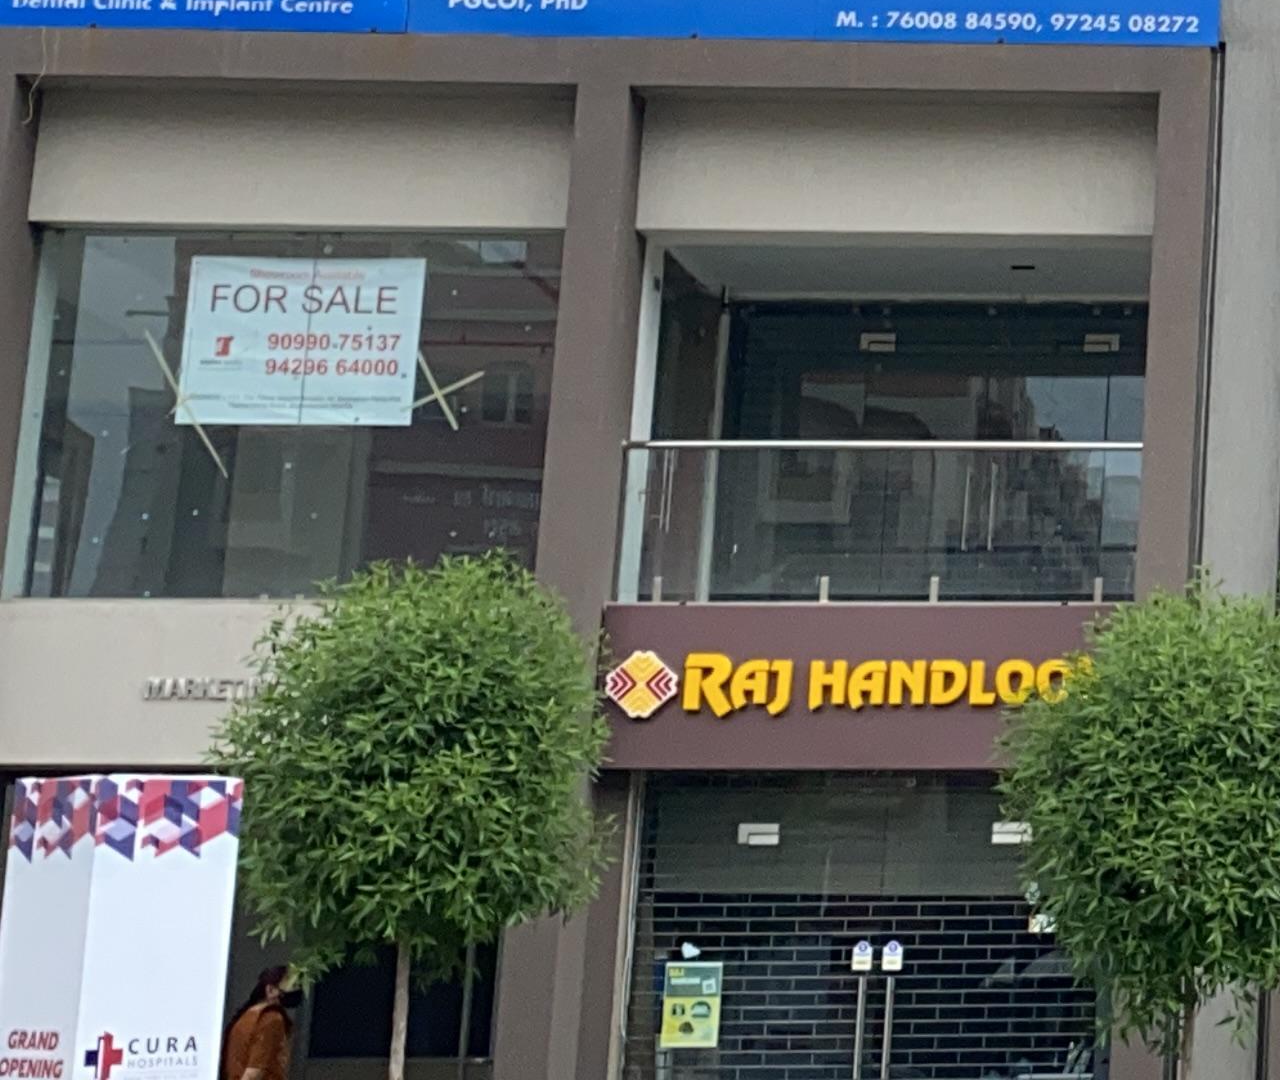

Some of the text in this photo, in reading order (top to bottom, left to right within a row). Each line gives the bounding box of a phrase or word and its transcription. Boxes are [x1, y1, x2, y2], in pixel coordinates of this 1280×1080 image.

[836, 11, 863, 28] M.
[886, 11, 957, 30] 76008
[965, 13, 1043, 32] 84590,
[1050, 14, 1121, 32] 97245
[1128, 15, 1199, 33] 08272
[210, 284, 399, 314] FOR SALE
[335, 359, 399, 376] 64000
[682, 652, 1093, 718] RAJ HANDLOO
[8, 1030, 59, 1051] GRAND
[128, 1036, 198, 1055] CURA
[0, 1057, 64, 1079] OPENING
[127, 1056, 198, 1069] HOSPITALS
